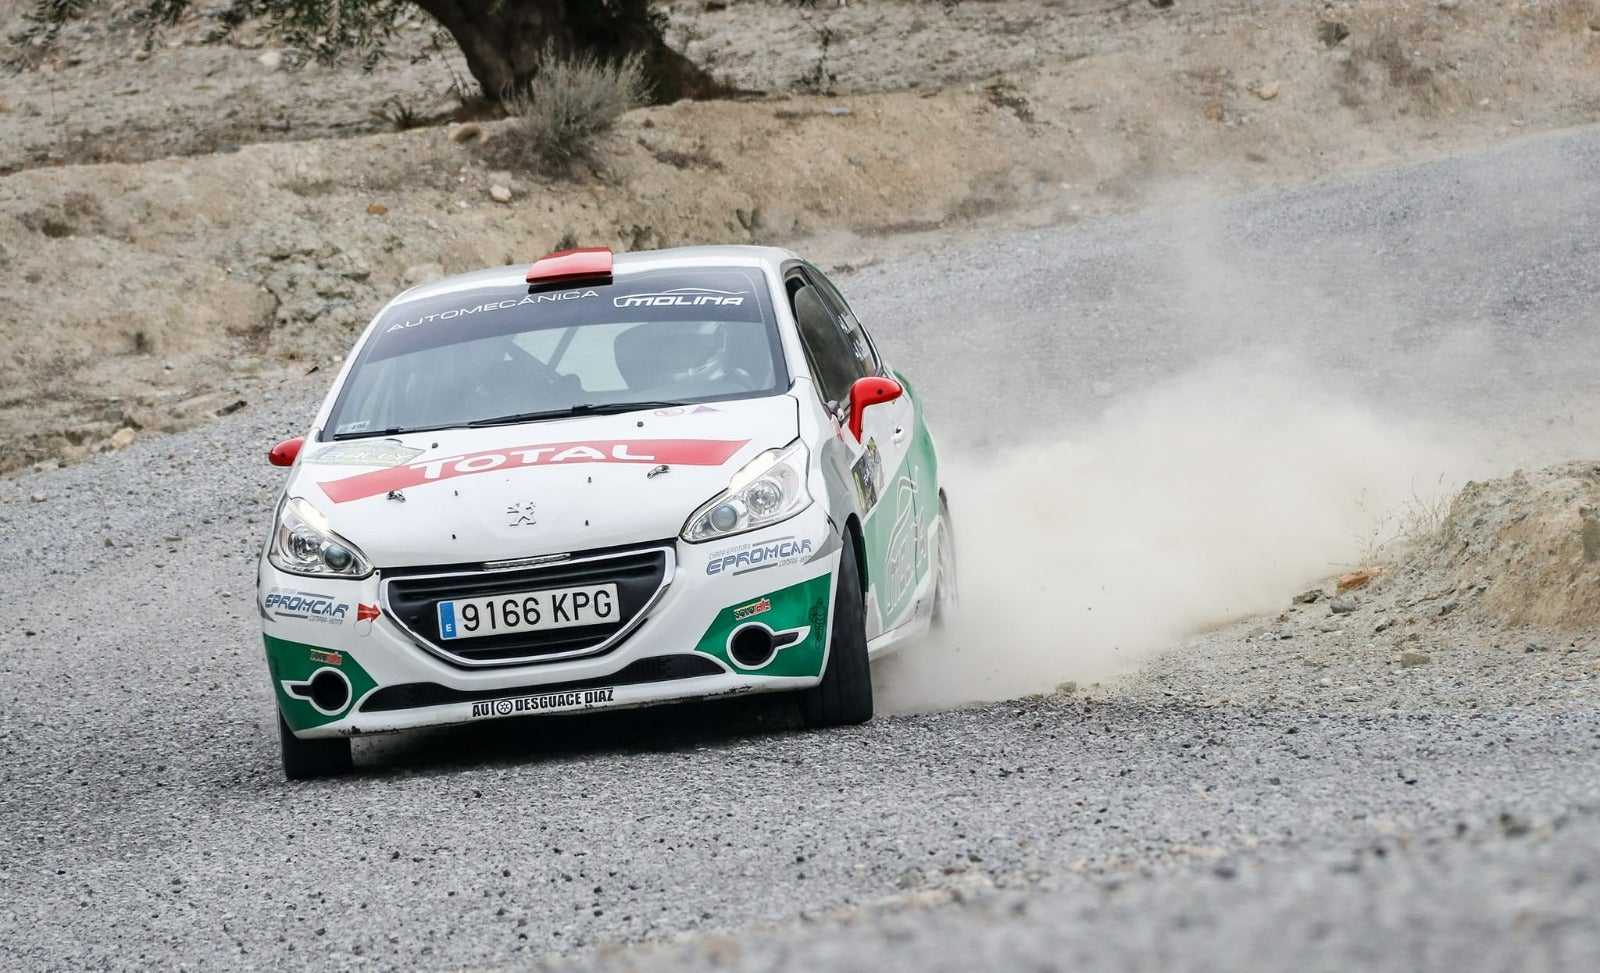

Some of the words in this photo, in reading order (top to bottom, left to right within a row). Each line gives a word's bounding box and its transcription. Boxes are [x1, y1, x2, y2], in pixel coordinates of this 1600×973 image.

[619, 295, 745, 308] MOLINA
[408, 443, 657, 481] TOTAL
[706, 539, 812, 575] EPROMCAR
[265, 594, 349, 618] EPROMCAR
[446, 624, 452, 632] E
[461, 596, 541, 632] 9166
[551, 589, 612, 623] KPG
[515, 693, 582, 712] DESGUACE
